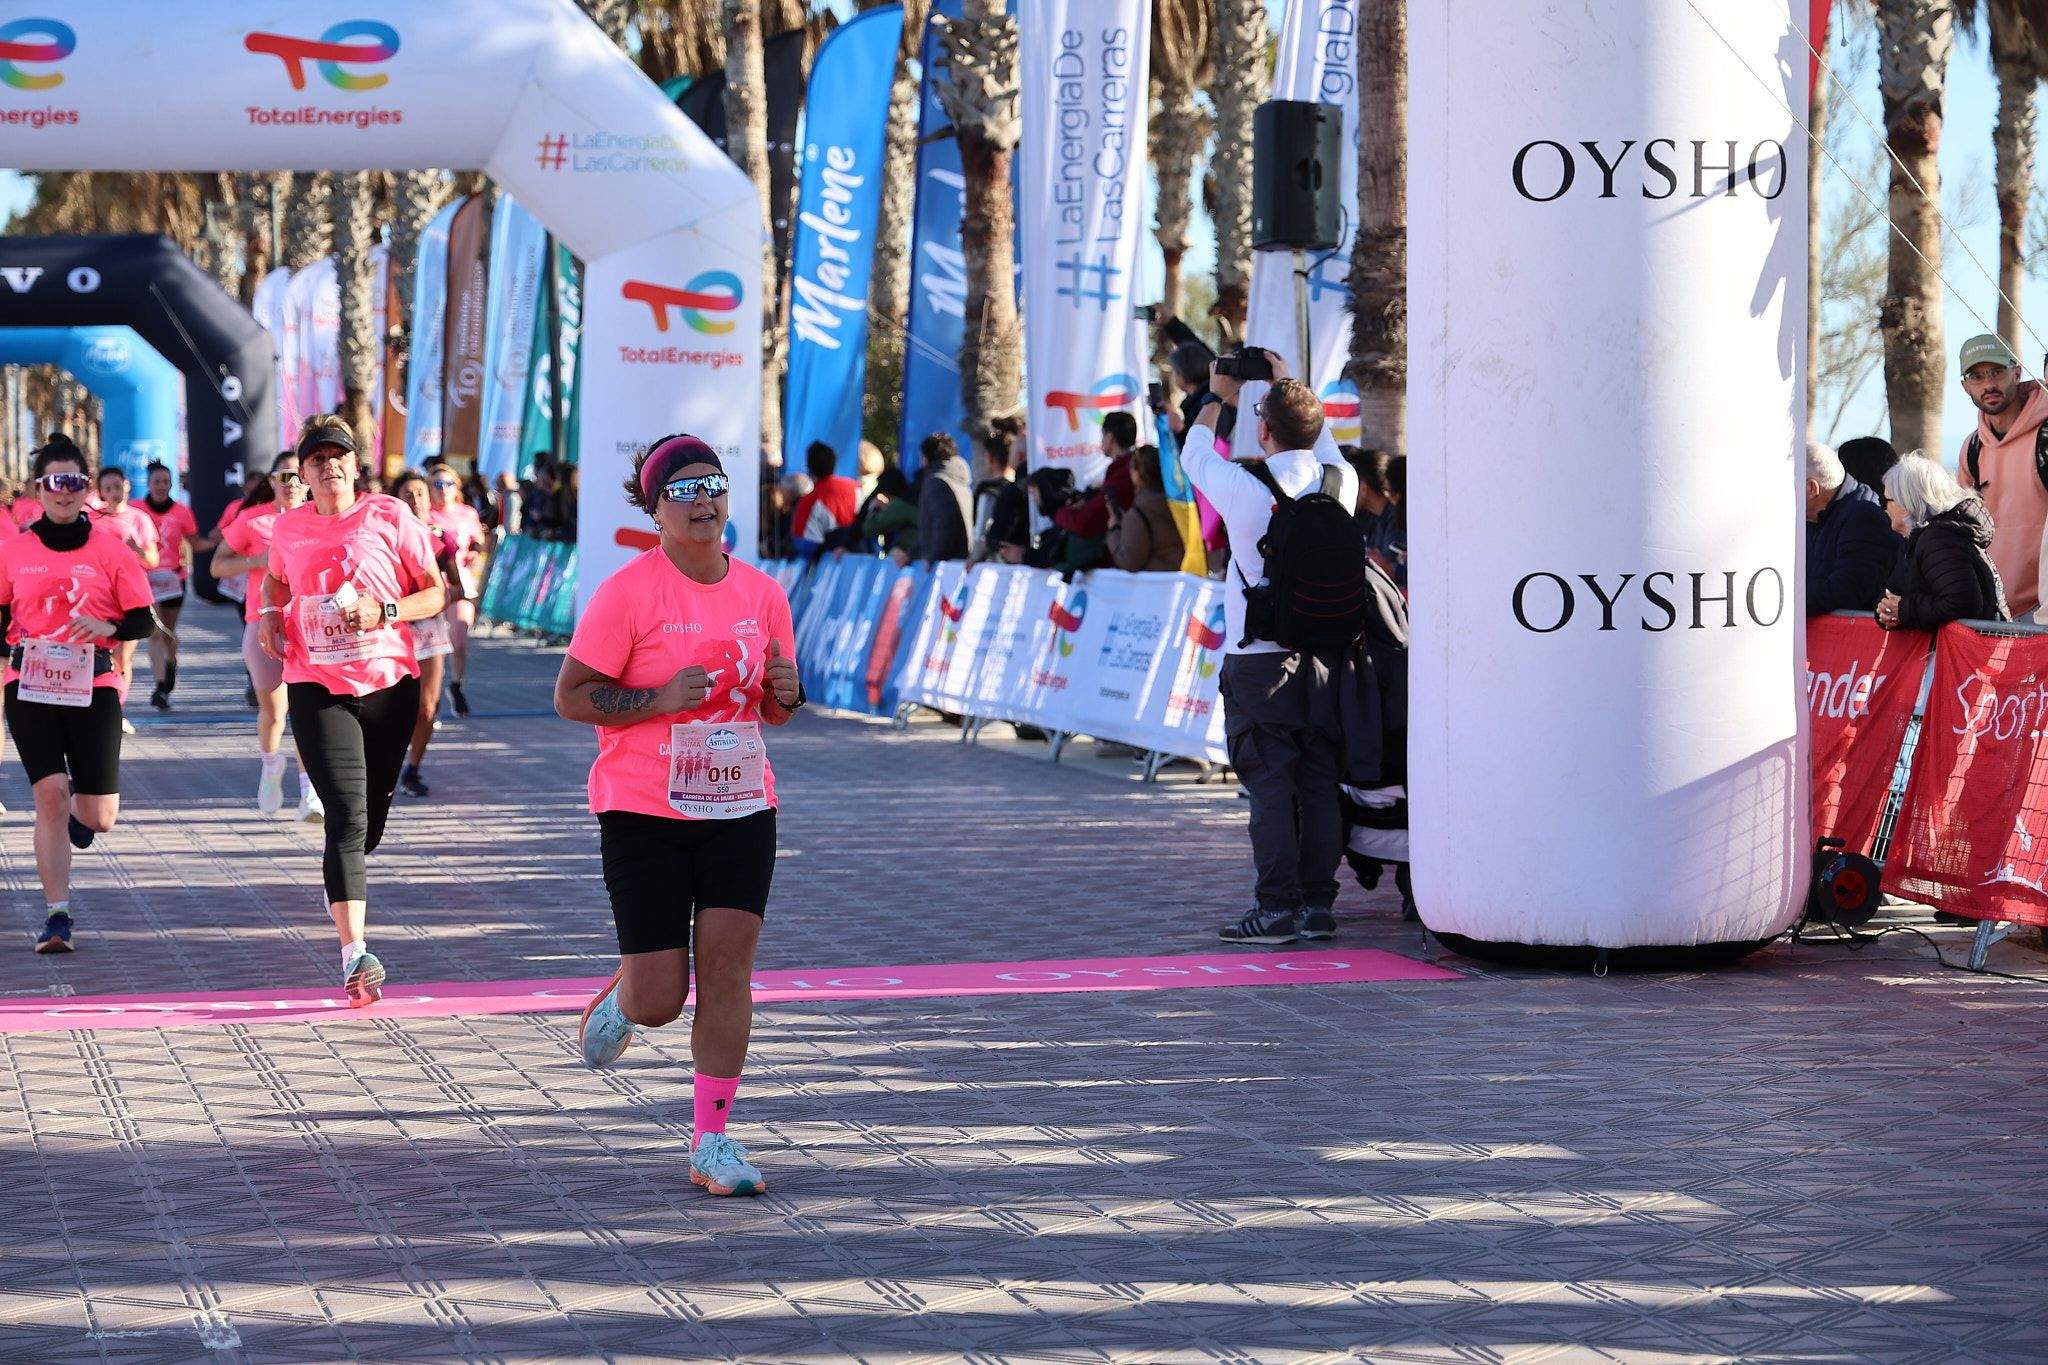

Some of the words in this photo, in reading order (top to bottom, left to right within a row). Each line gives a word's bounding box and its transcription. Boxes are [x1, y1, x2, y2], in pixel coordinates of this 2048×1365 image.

[245, 107, 403, 130] TotalEnergies
[1094, 27, 1127, 242] LasCarreras
[1512, 138, 1787, 202] OYSHO
[792, 144, 865, 350] Marlene
[620, 347, 743, 369] TotalEnergies
[1512, 566, 1784, 633] OYSHO
[662, 623, 703, 634] OYSHO
[45, 668, 73, 682] 016
[708, 765, 741, 783] 016
[679, 803, 714, 814] OYSHO
[995, 961, 1351, 982] OYSHO
